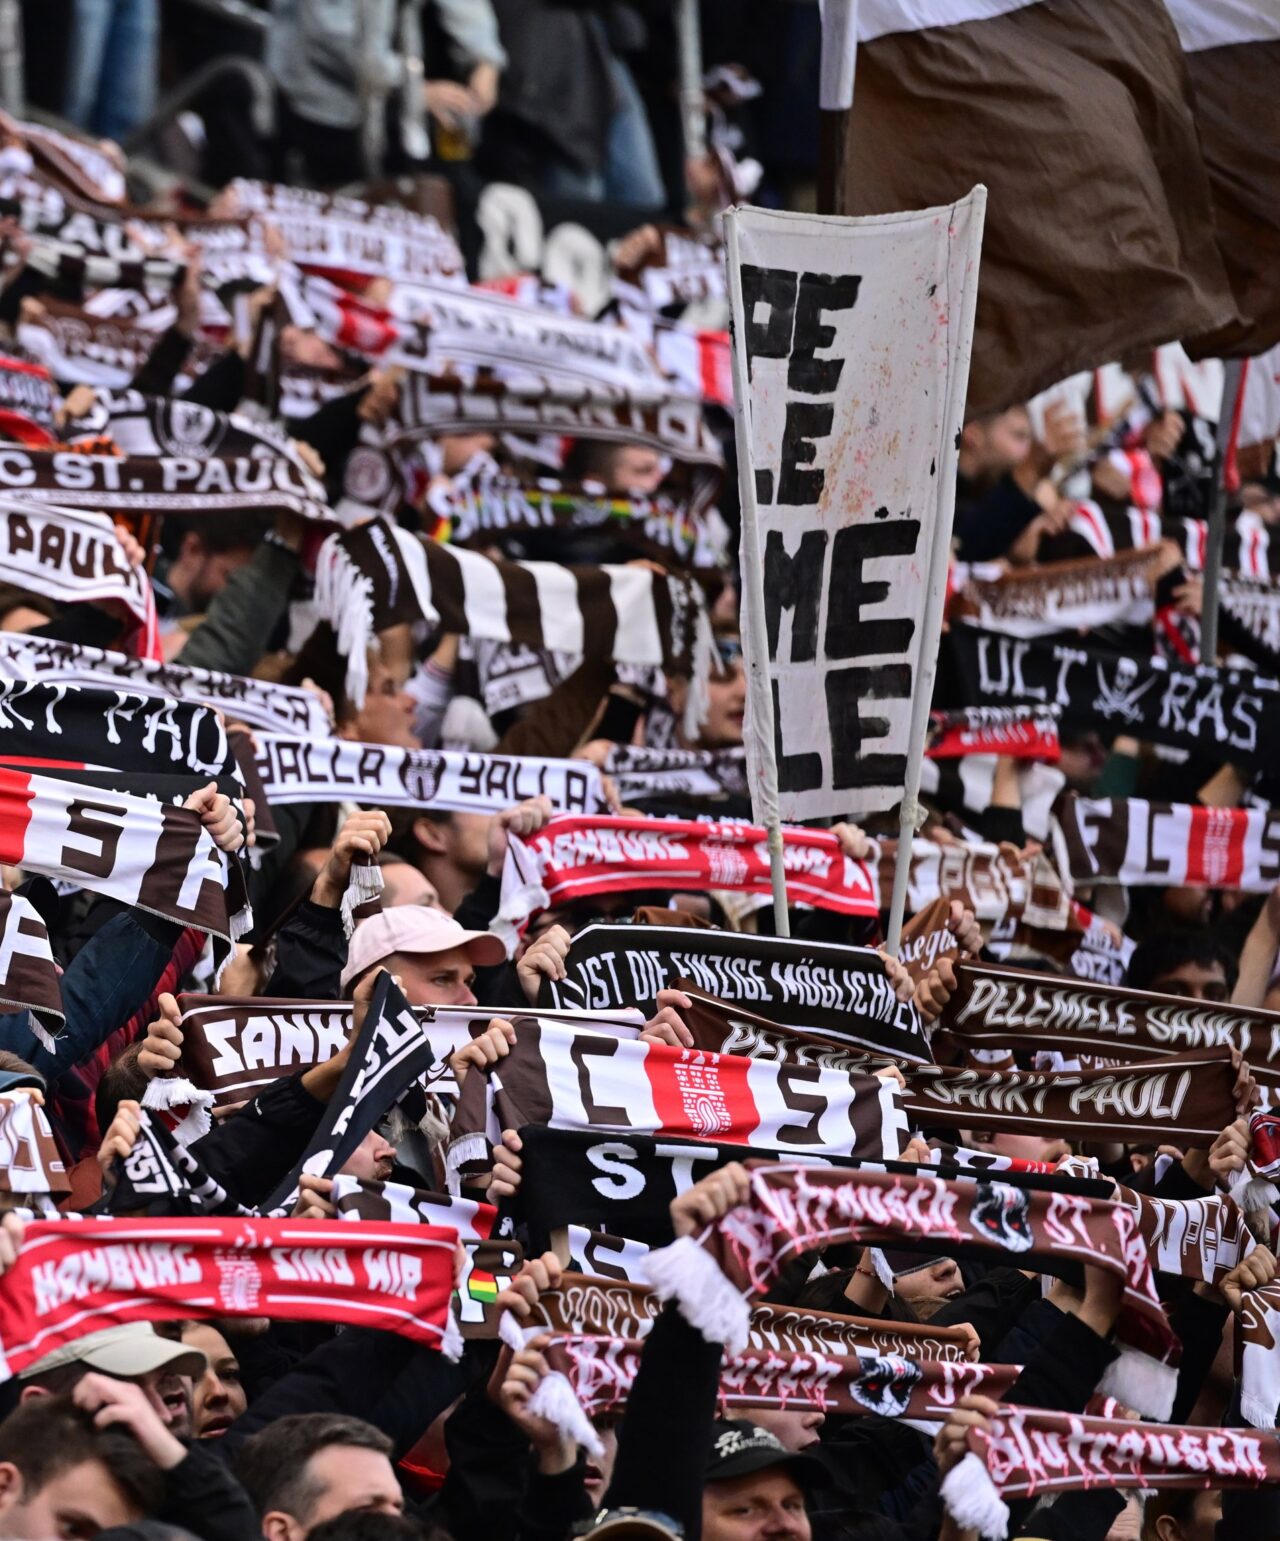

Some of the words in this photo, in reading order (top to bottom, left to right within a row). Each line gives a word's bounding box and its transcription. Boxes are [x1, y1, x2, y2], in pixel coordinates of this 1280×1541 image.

[756, 400, 835, 506] E
[764, 519, 921, 662] ME
[771, 663, 913, 791] LE
[955, 977, 1140, 1036] PELEMELE
[1145, 1005, 1266, 1052] SANKT
[923, 1068, 1083, 1114] SANKT
[1069, 1068, 1192, 1122] PAULI
[31, 1244, 205, 1318] HAMBURG
[269, 1247, 356, 1287] SIND
[361, 1249, 424, 1301] WIR
